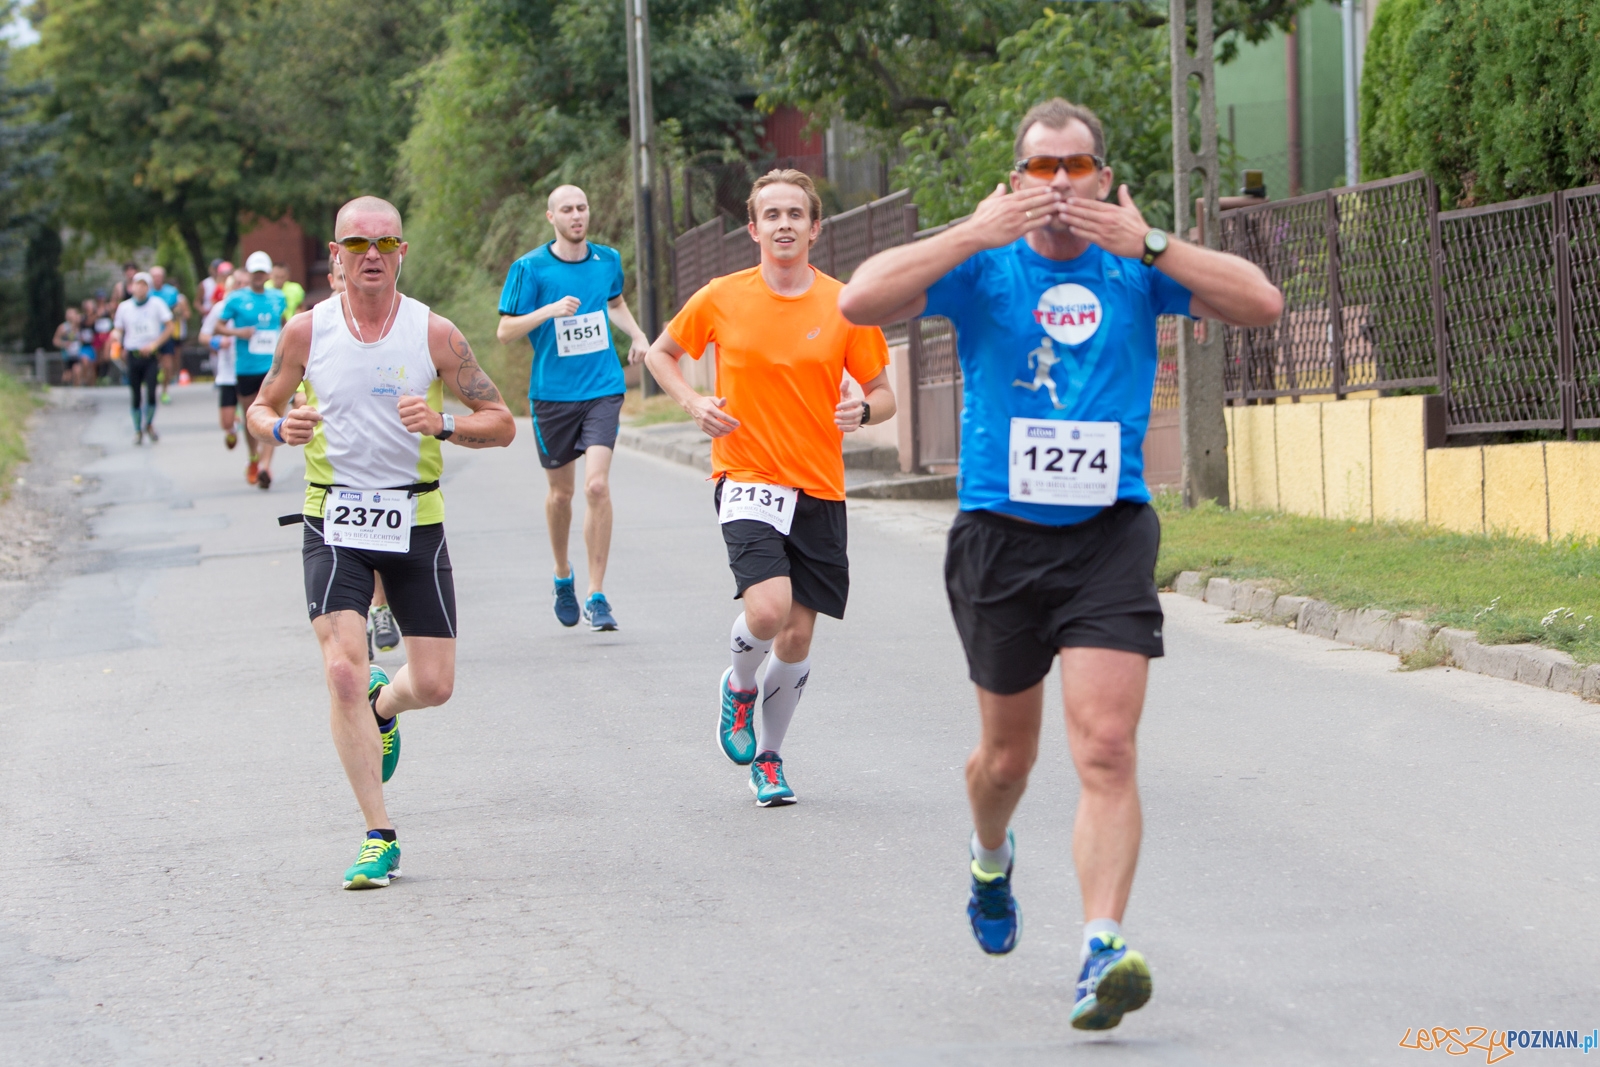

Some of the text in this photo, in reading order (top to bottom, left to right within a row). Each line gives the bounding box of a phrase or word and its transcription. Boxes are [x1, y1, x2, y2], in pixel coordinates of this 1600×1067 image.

[1032, 309, 1096, 326] TEAM
[563, 324, 601, 341] 1551
[1024, 446, 1108, 474] 1274
[729, 486, 785, 513] 2131
[333, 505, 402, 529] 2370
